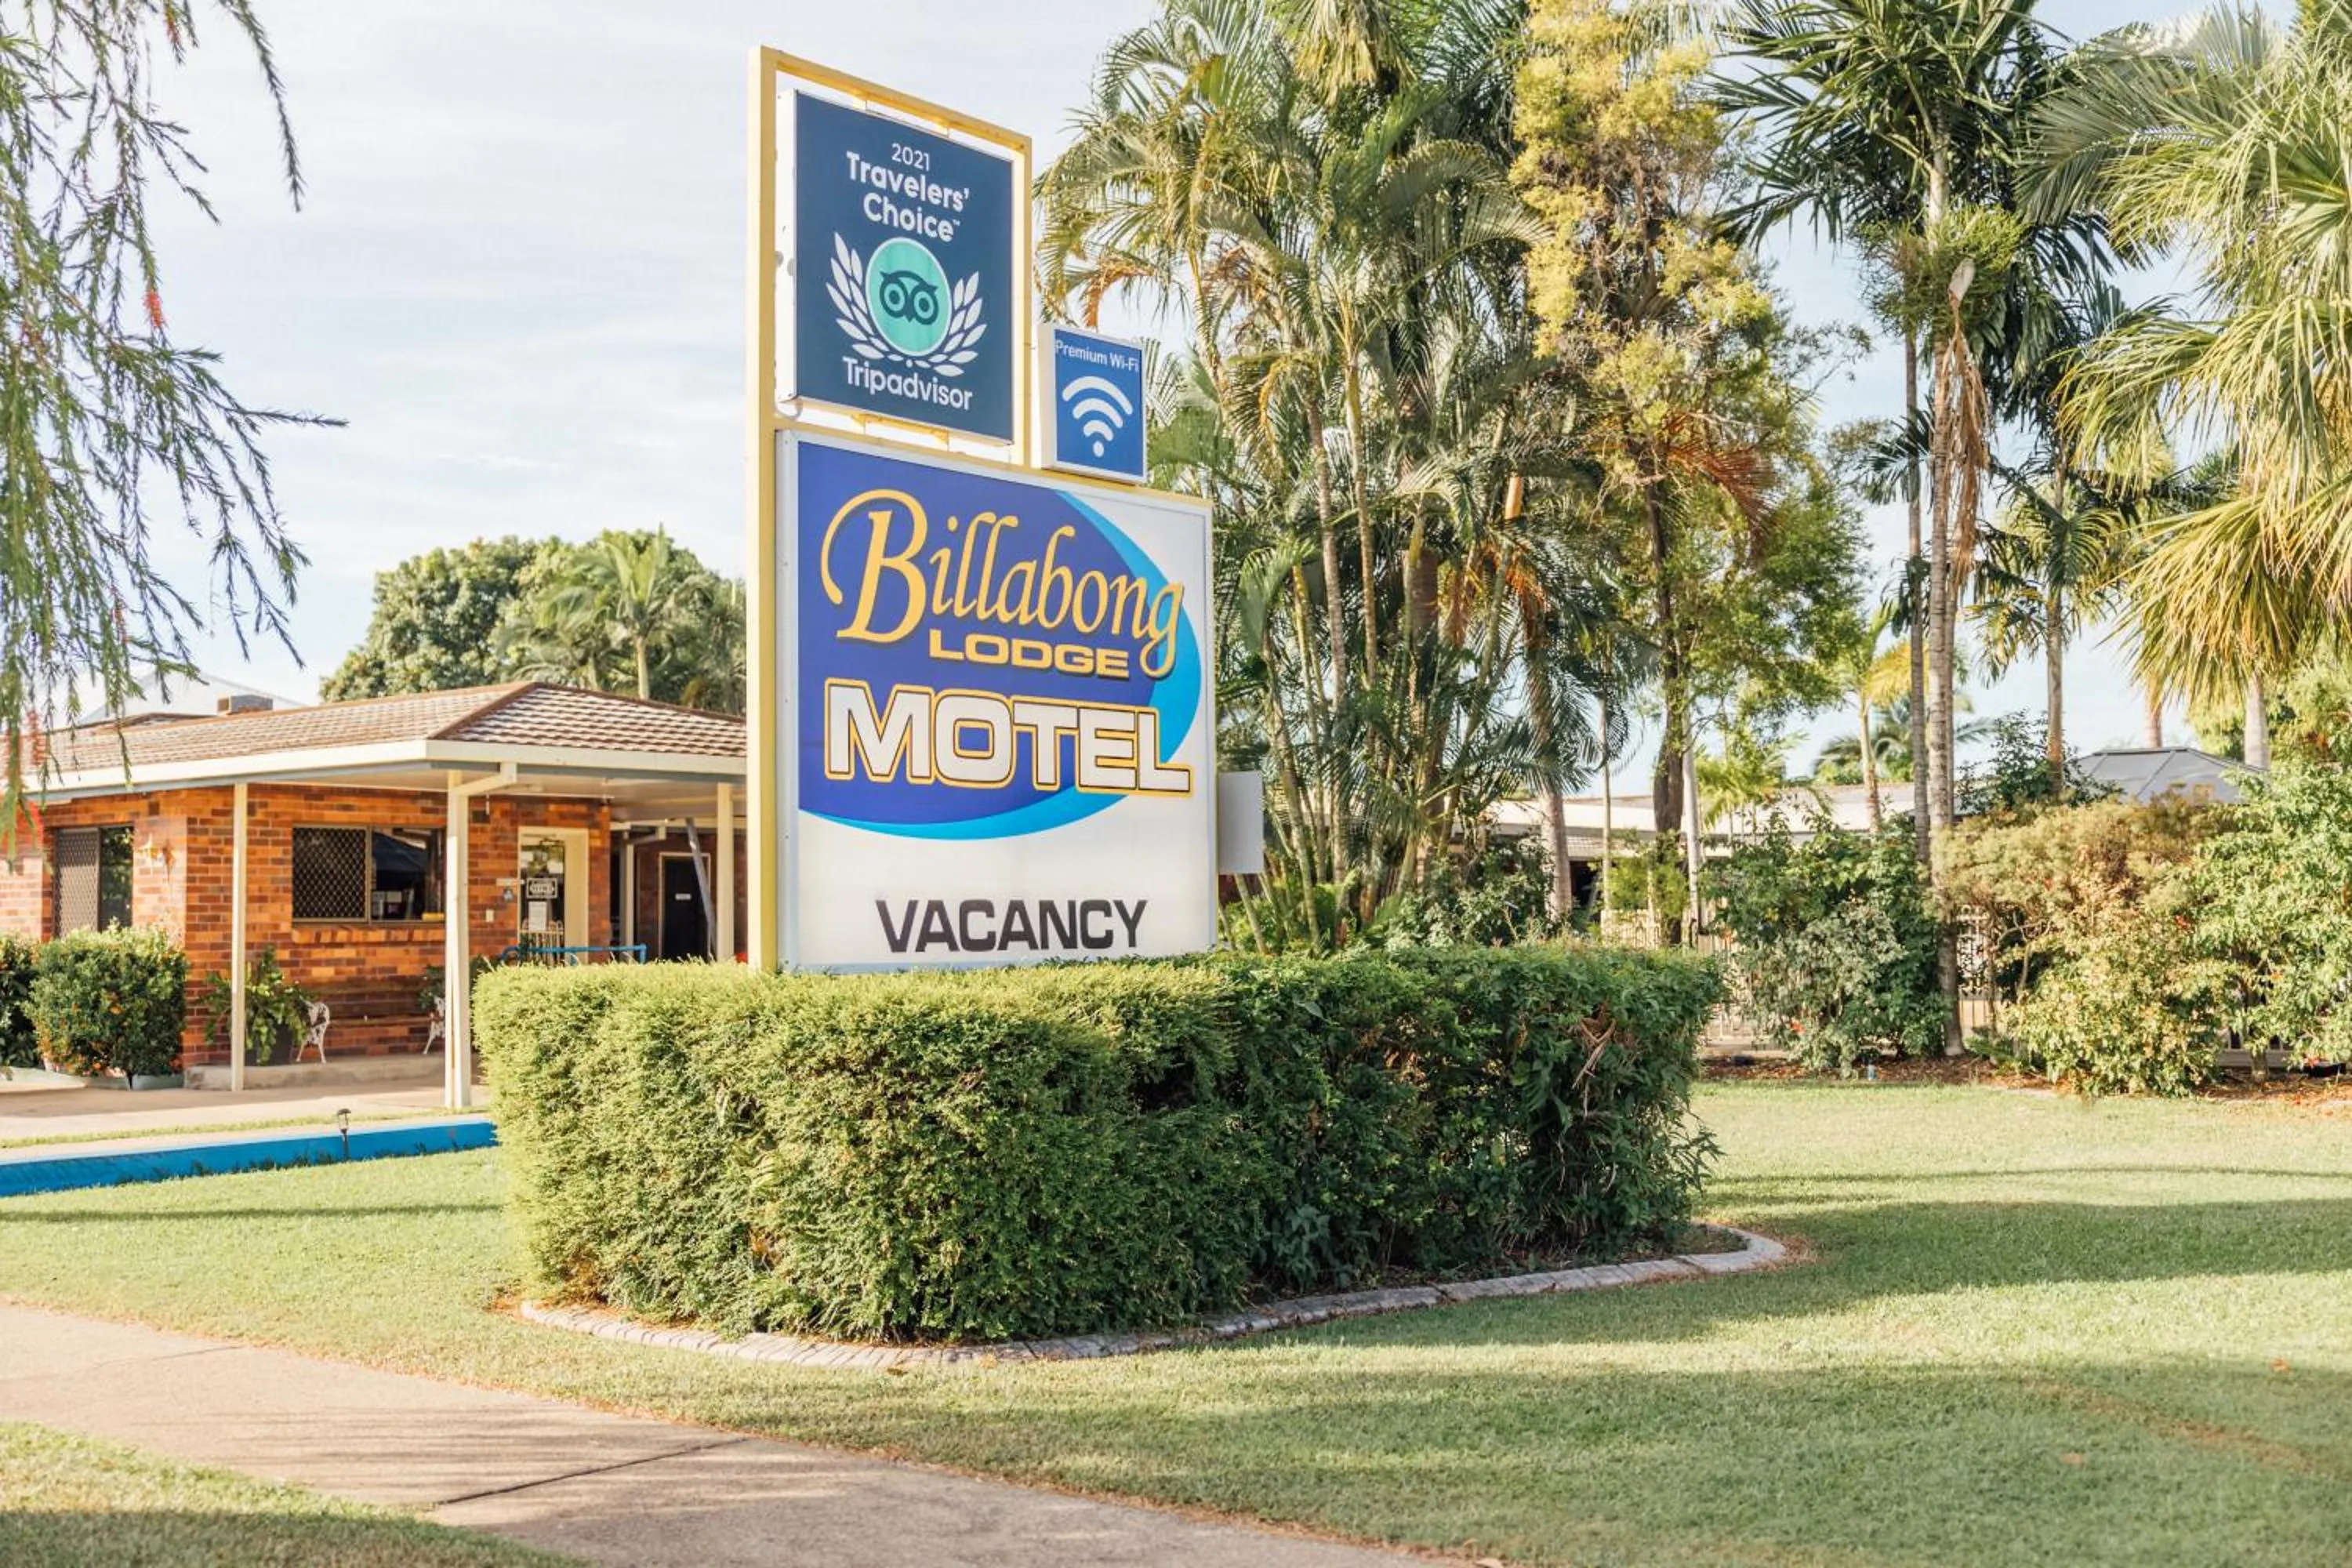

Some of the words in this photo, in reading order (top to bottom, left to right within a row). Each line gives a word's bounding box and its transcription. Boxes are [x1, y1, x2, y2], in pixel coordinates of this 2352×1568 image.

[891, 142, 930, 172] 2021
[1054, 339, 1108, 366] Premium
[1109, 352, 1139, 372] Wi-Fi
[842, 356, 972, 411] Tripadvisor
[820, 488, 1185, 677] Billabong
[929, 630, 1130, 678] LODGE
[824, 677, 1194, 798] MOTEL
[875, 898, 1149, 953] VACANCY
